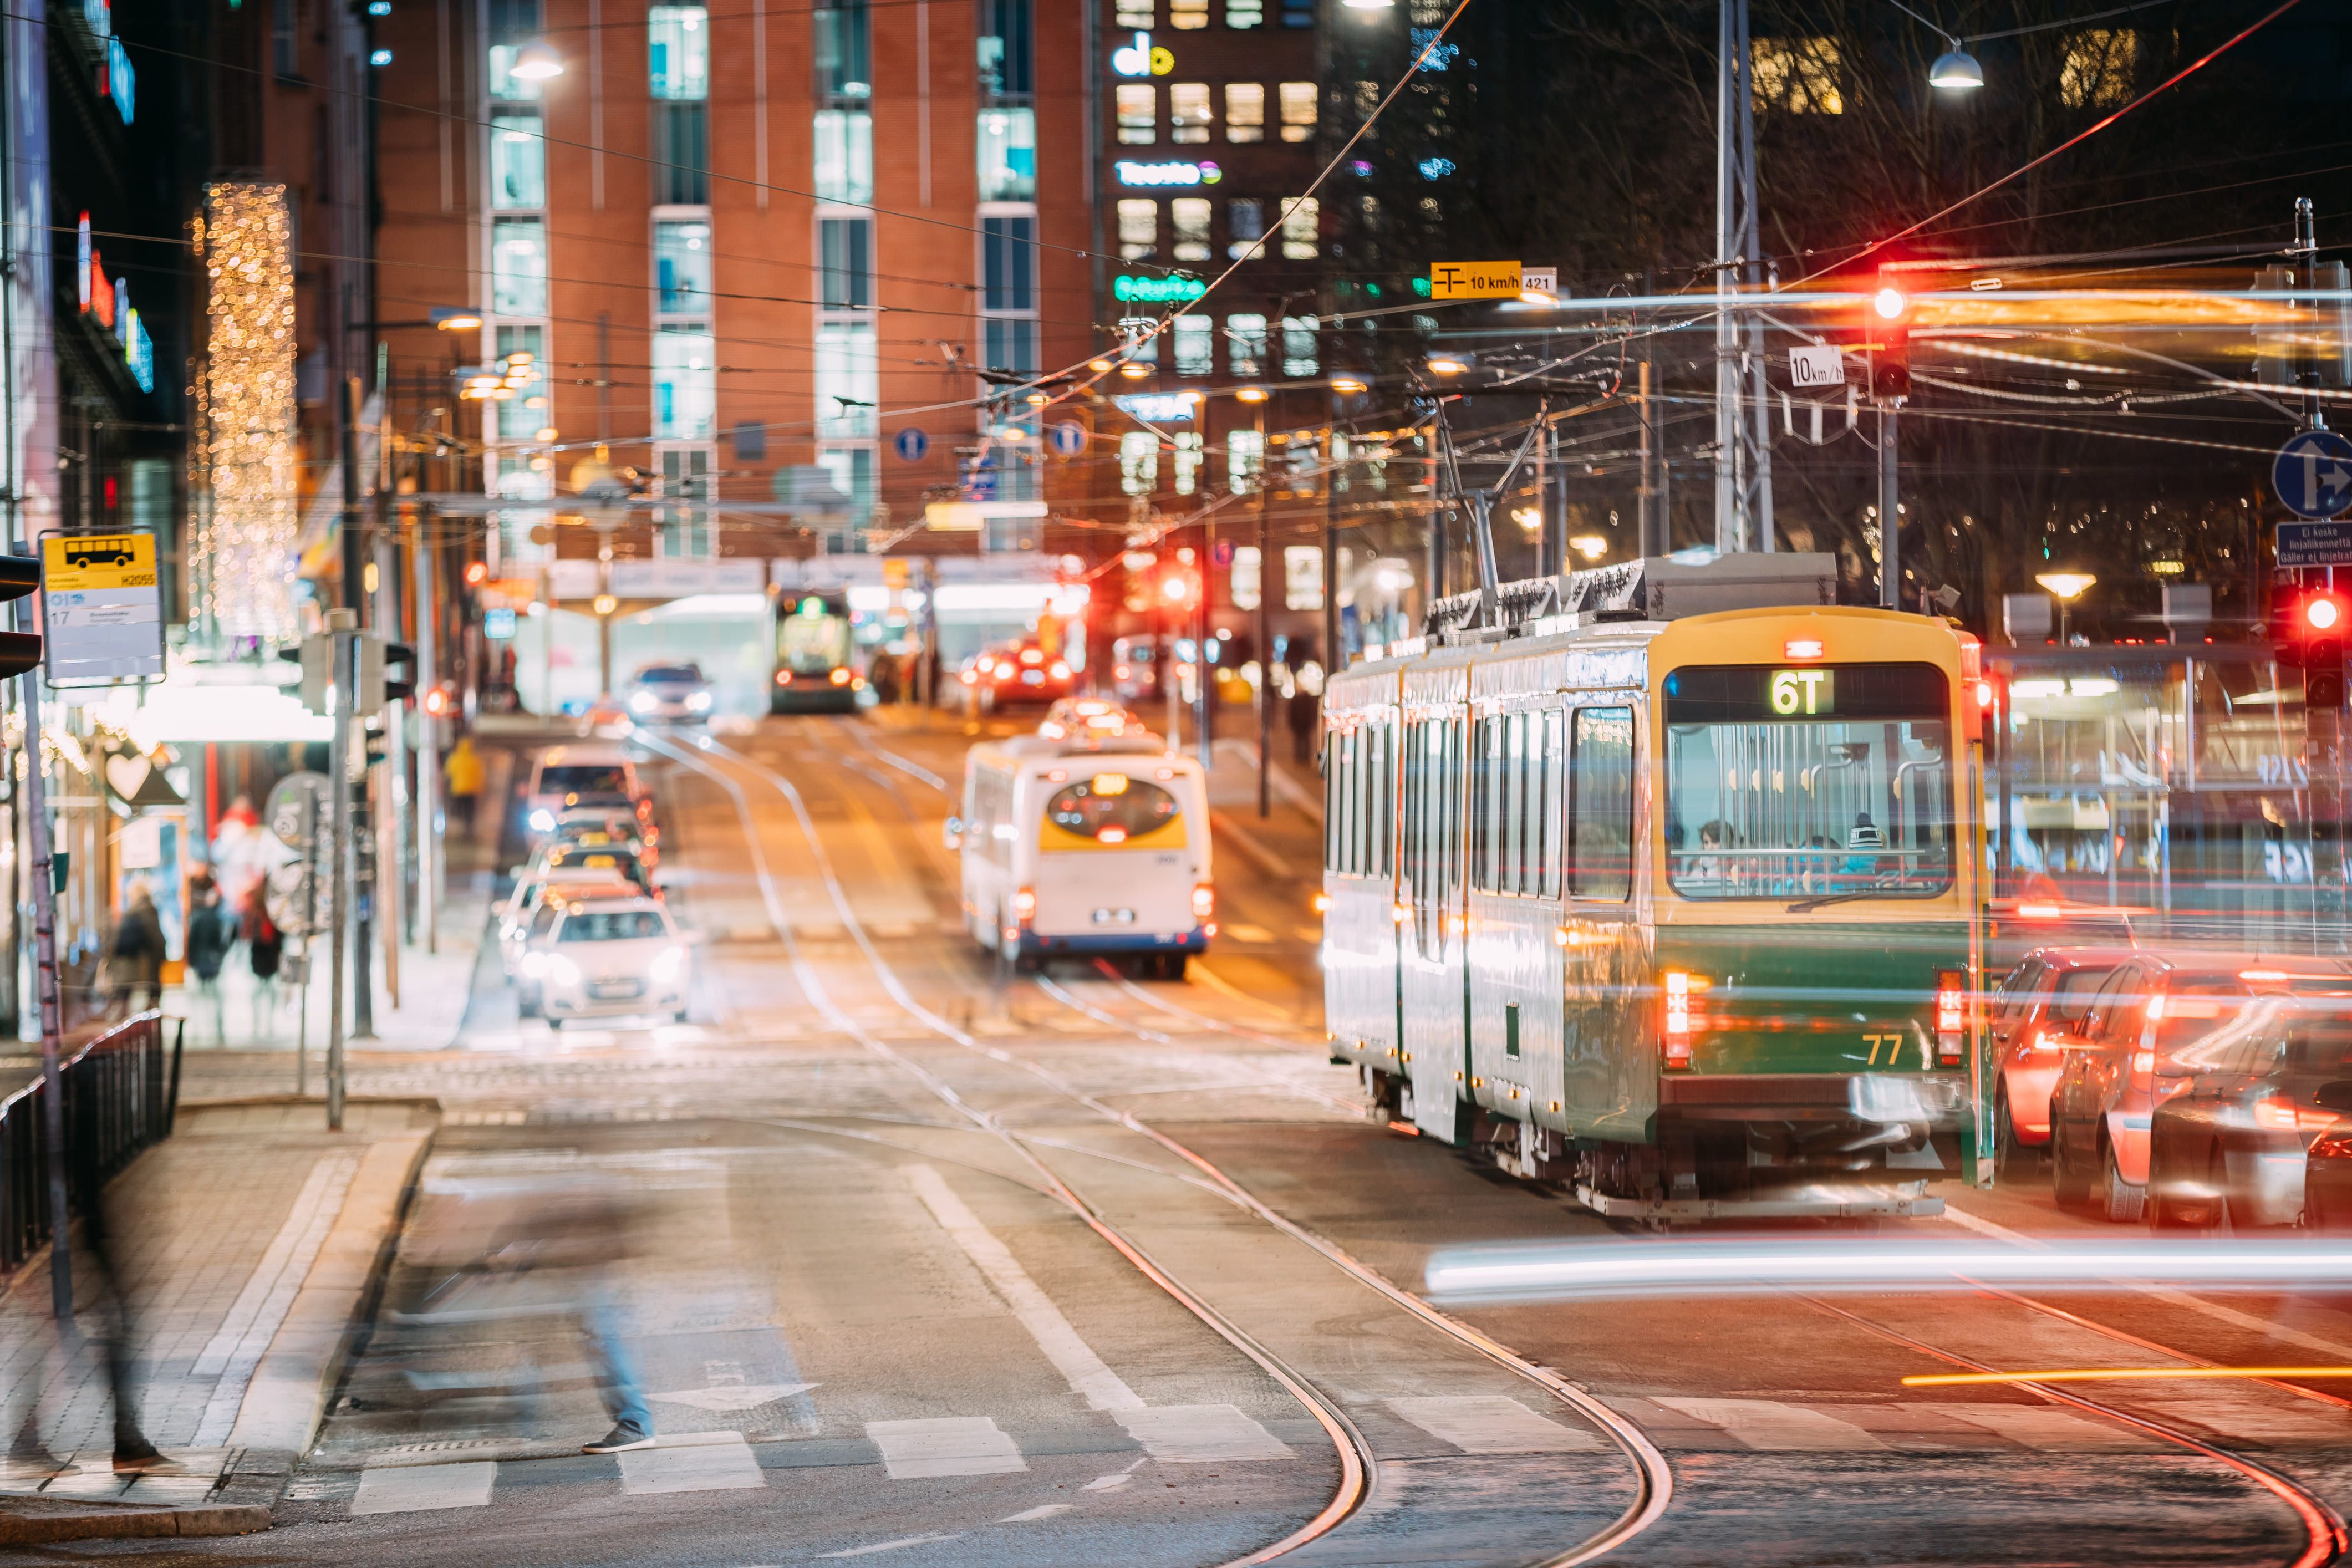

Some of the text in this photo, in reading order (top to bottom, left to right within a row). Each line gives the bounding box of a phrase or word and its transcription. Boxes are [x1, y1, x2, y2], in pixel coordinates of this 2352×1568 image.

[1470, 274, 1519, 289] 10 km/h
[1525, 278, 1549, 290] 421
[2302, 526, 2338, 538] Ei koske
[2289, 537, 2351, 550] linjaliikennettä
[2280, 552, 2305, 563] Gäller
[2308, 551, 2317, 562] ej
[50, 610, 70, 626] 17
[1772, 671, 1824, 715] 6T
[1862, 1034, 1903, 1065] 77
